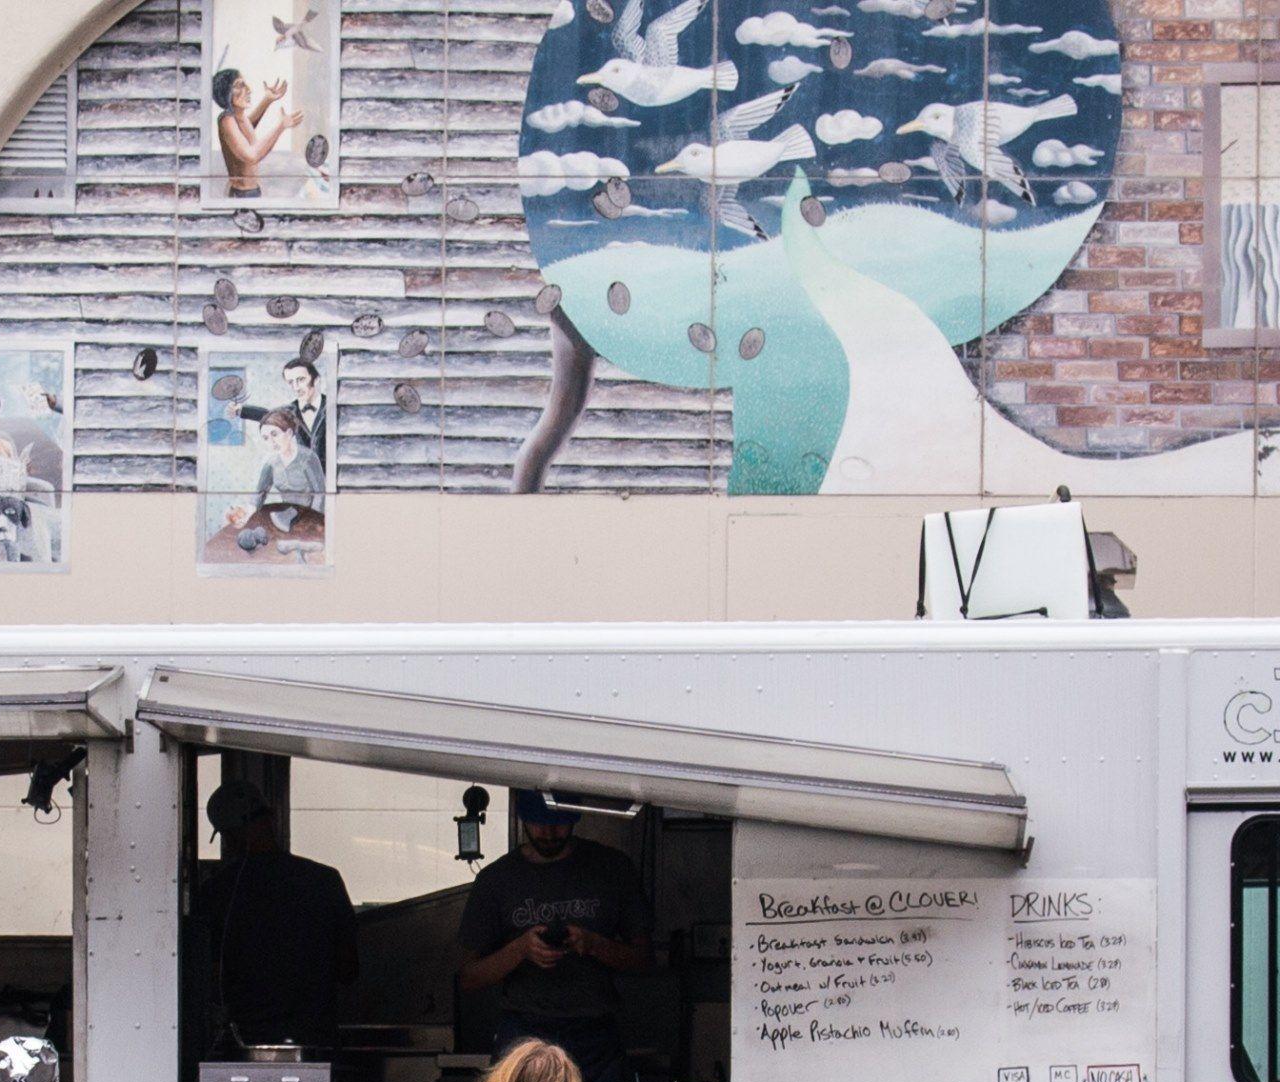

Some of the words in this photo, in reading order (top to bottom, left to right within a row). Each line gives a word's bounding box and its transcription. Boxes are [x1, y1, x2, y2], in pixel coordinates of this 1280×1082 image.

[512, 898, 600, 928] clover
[759, 893, 861, 919] Breakfast
[865, 895, 885, 916] @
[761, 998, 819, 1022] Popover
[761, 1022, 804, 1051] Apple
[810, 1019, 871, 1042] Pistachio
[879, 1019, 935, 1040] Muffin
[1003, 1071, 1025, 1082] VISA
[1054, 1070, 1071, 1080] MC
